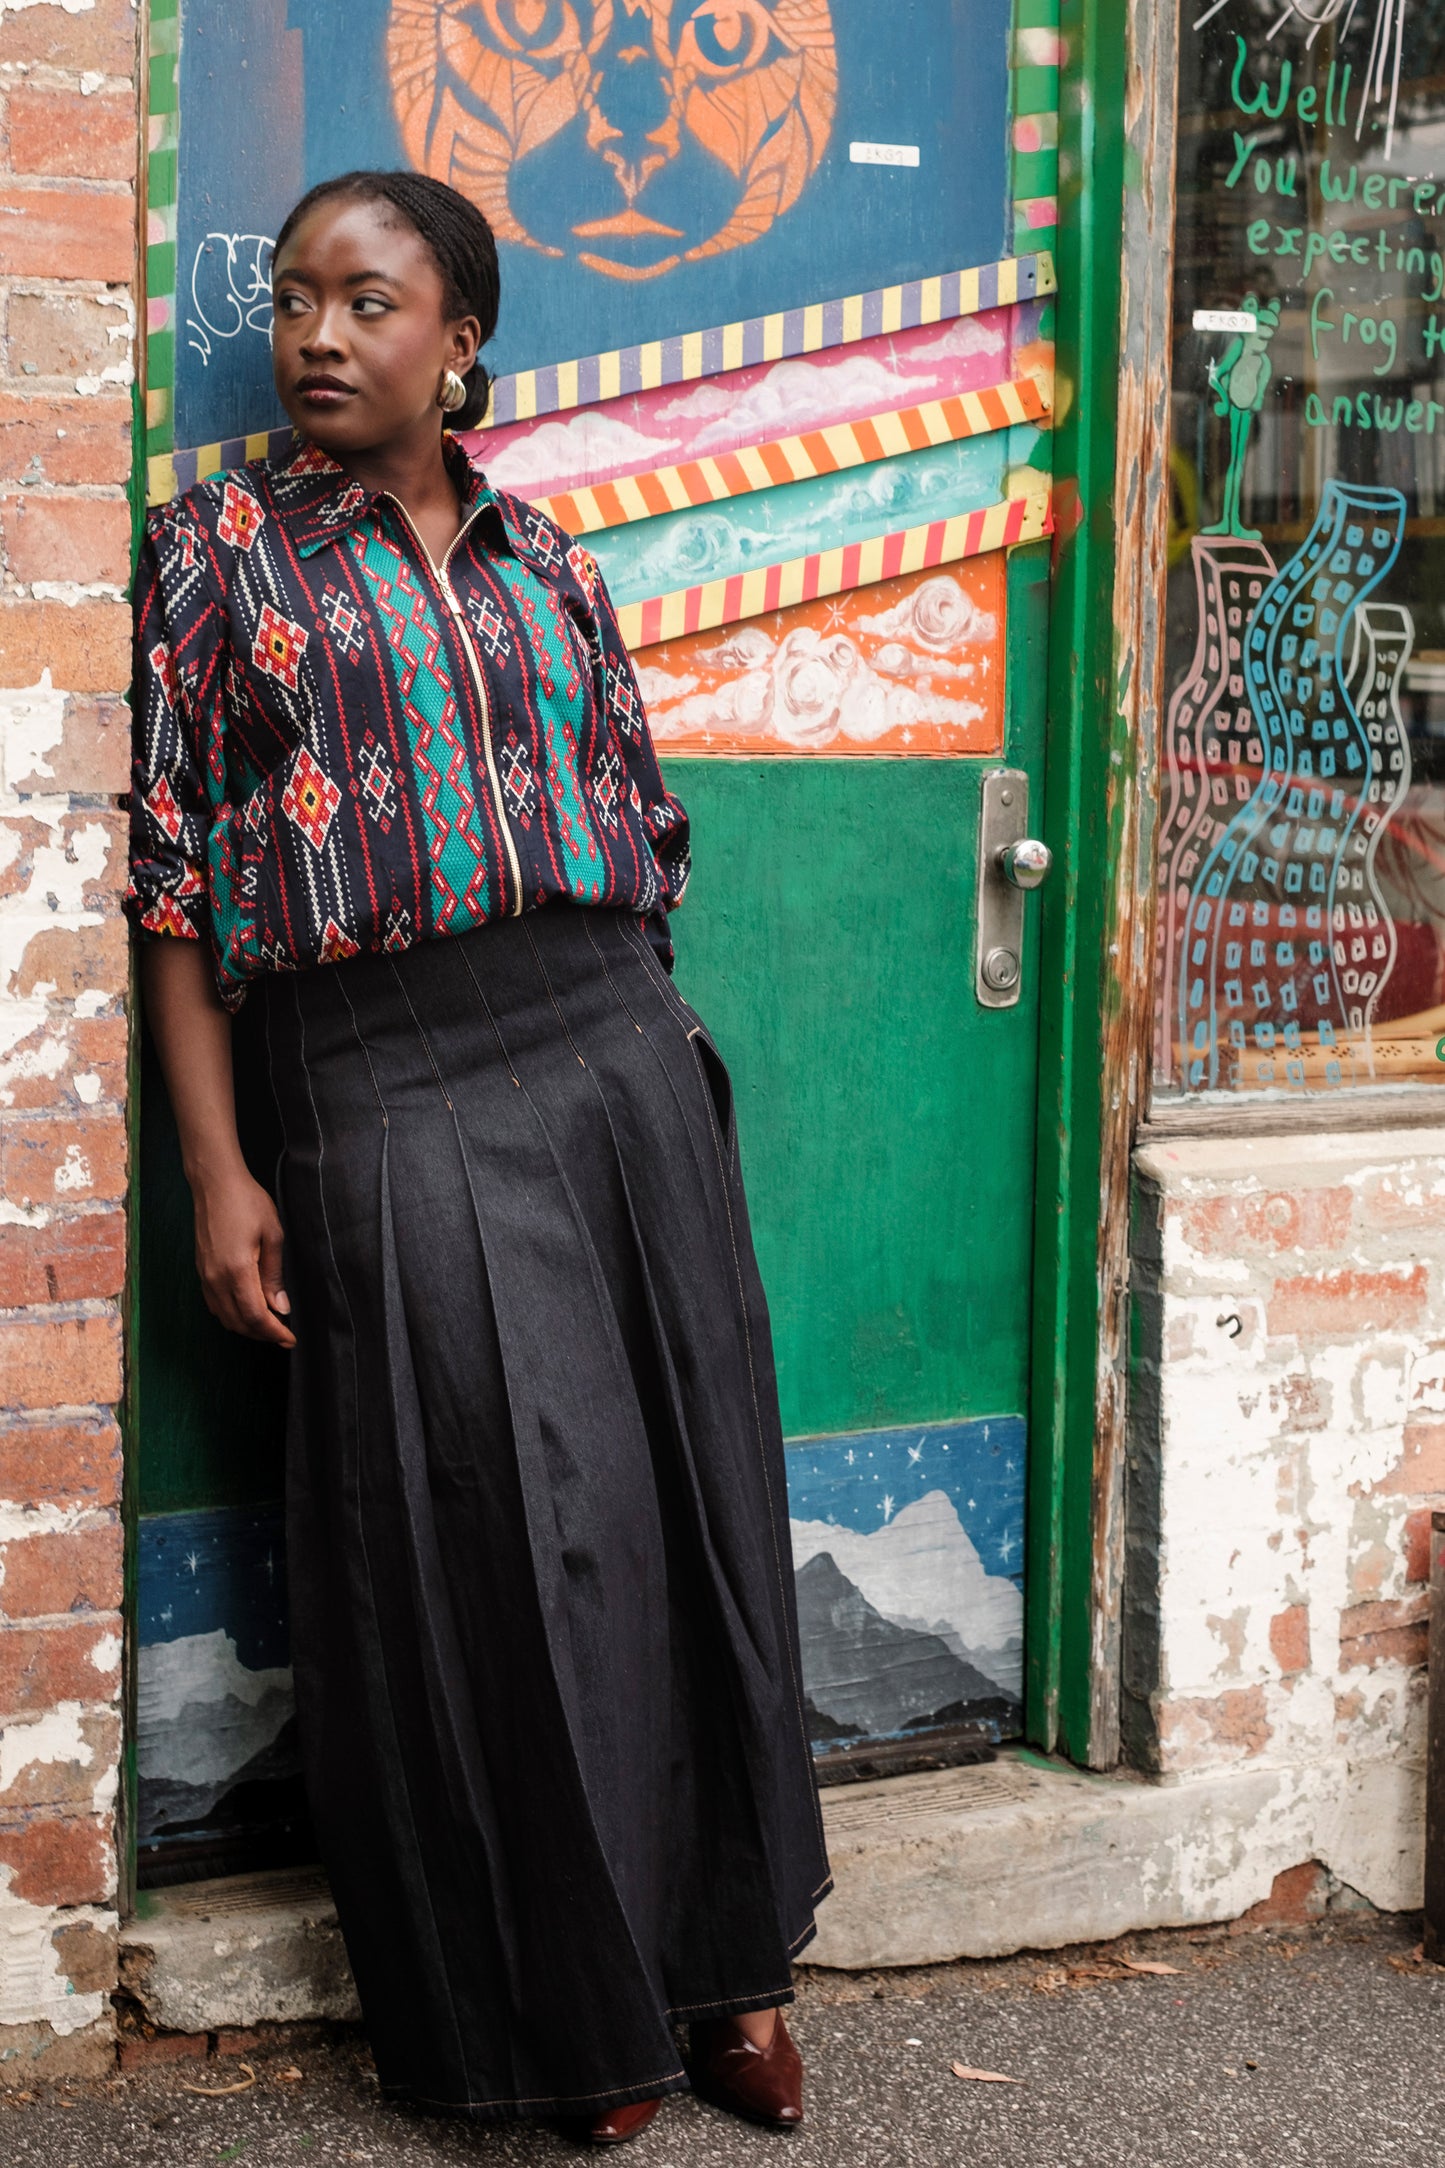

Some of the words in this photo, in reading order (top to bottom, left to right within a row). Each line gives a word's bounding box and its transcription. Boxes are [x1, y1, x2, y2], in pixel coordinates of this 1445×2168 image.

[1225, 131, 1297, 197] You
[1247, 218, 1444, 302] expecting
[1311, 287, 1397, 376] frog
[1305, 391, 1444, 434] answer
